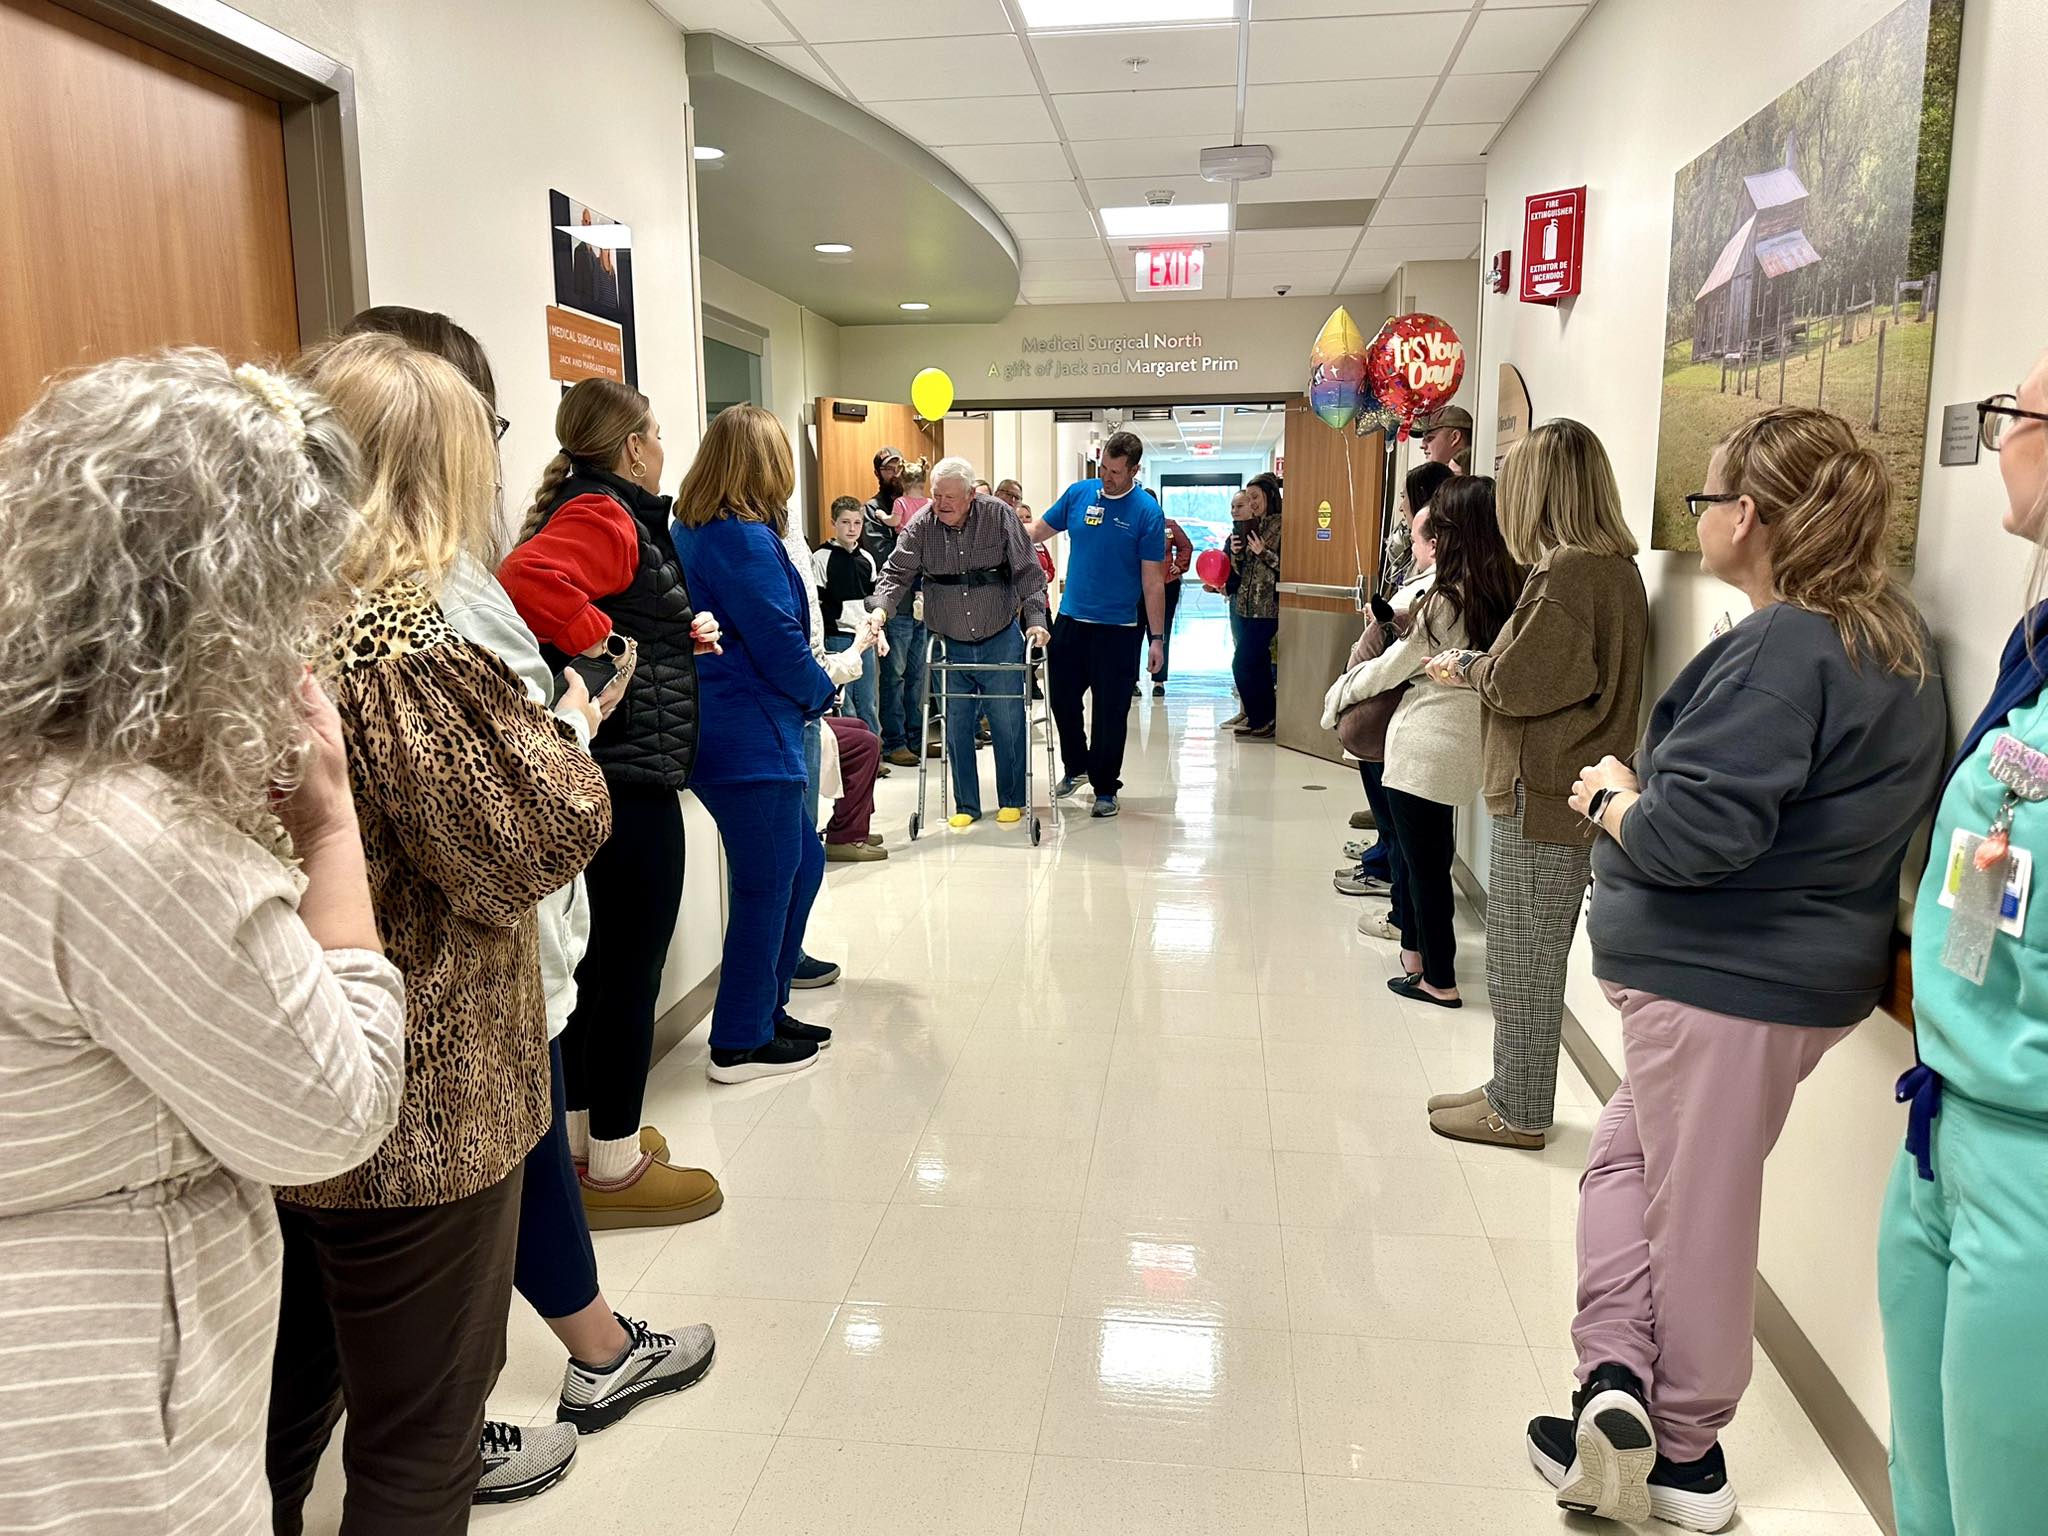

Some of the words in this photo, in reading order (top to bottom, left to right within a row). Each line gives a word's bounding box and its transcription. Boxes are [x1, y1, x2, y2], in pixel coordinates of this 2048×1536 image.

[1530, 207, 1573, 220] EXTINGUISHER
[1545, 199, 1559, 208] FIRE
[1149, 252, 1191, 287] EXIT
[1529, 262, 1559, 274] EXTINTOR
[1559, 260, 1568, 270] DE
[1532, 271, 1565, 282] INCENDIOS
[551, 324, 577, 343] MEDICAL
[577, 332, 603, 350] SURGICAL
[1021, 334, 1084, 353] Medical
[1087, 333, 1149, 354] Surgical
[1153, 330, 1202, 348] North
[1425, 331, 1461, 361] Your
[559, 354, 572, 366] JACK
[572, 358, 582, 368] AND
[583, 361, 607, 374] MARGARET
[987, 363, 999, 377] A
[1003, 360, 1031, 381] gift
[1037, 359, 1054, 376] of
[1055, 359, 1088, 378] Jack
[1093, 359, 1121, 375] and
[1126, 358, 1198, 378] Margaret
[1202, 356, 1239, 372] Prim
[1409, 360, 1457, 391] Day!
